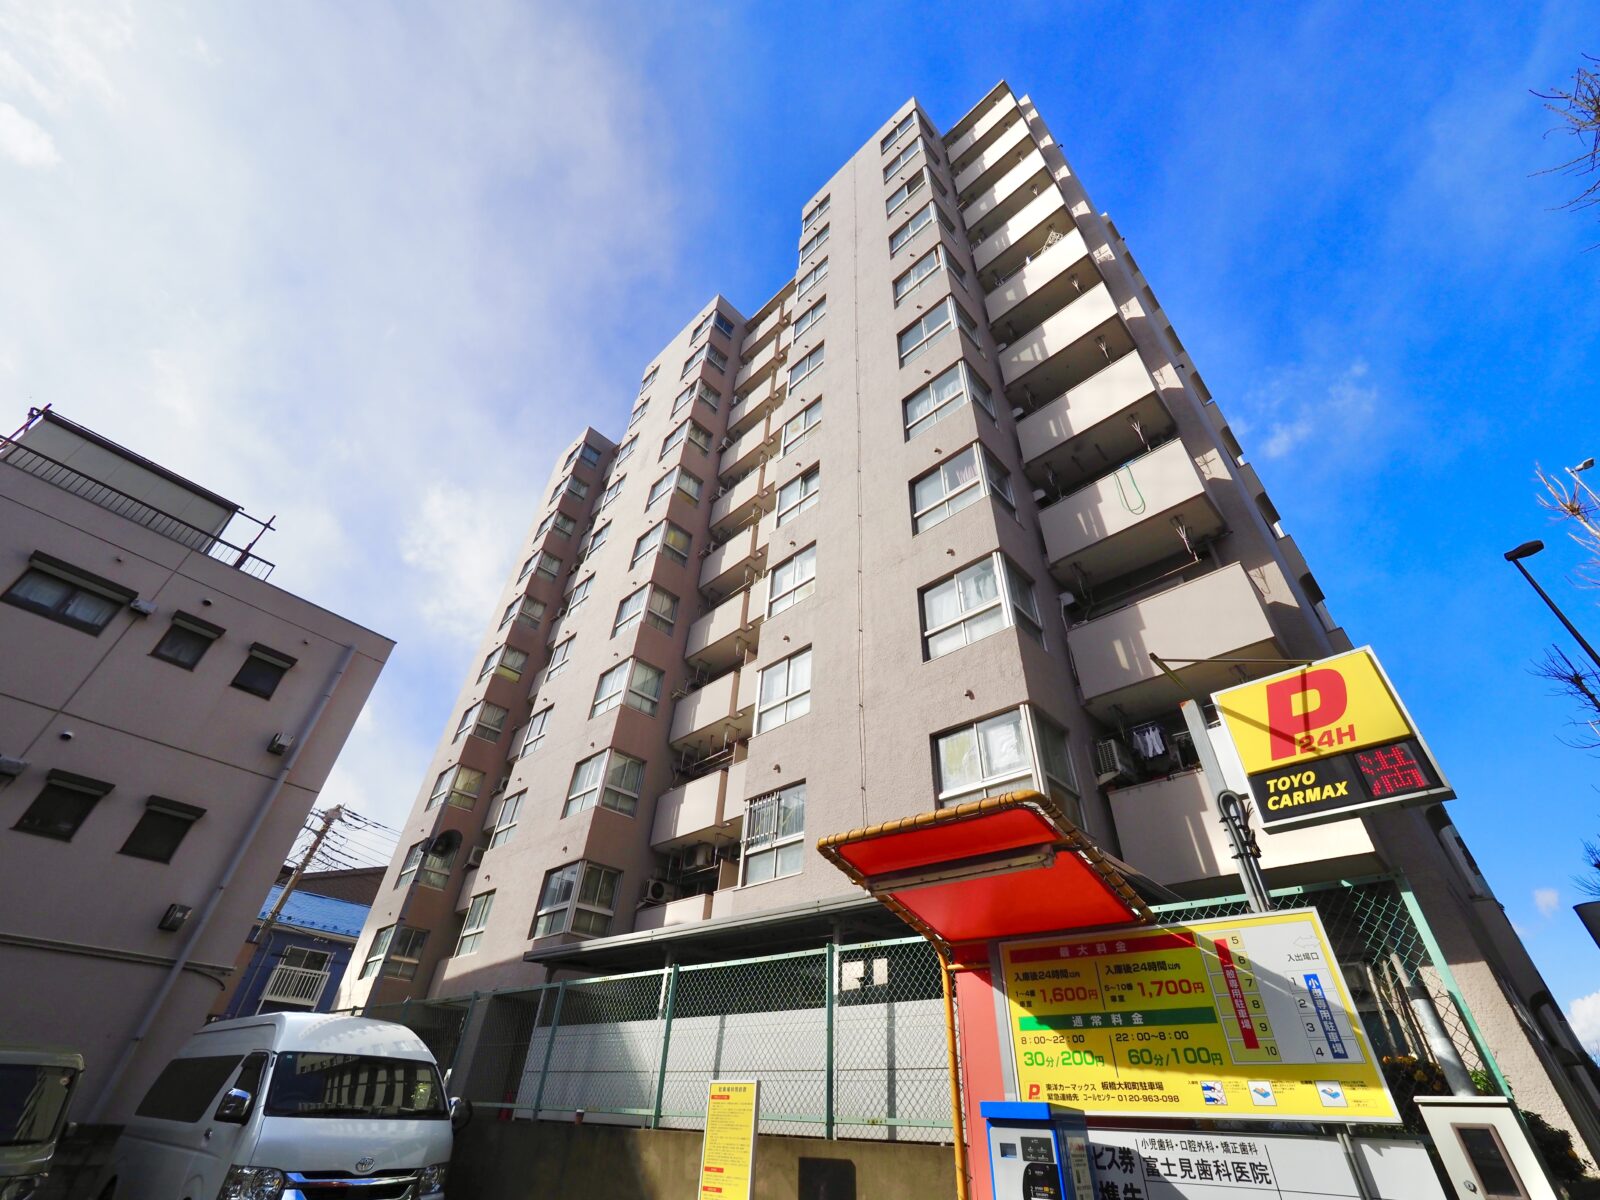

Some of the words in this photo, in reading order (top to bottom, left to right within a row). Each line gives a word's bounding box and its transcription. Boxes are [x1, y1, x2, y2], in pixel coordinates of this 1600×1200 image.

[1266, 668, 1347, 761] P
[1299, 724, 1356, 754] 24H
[1359, 746, 1425, 797] 満
[1266, 771, 1316, 793] TOYO
[1267, 781, 1348, 811] CARMAX
[1231, 937, 1239, 945] 5
[1059, 941, 1127, 957] 最大料金
[1238, 956, 1246, 965] 6
[1287, 952, 1320, 962] 入出場口
[1245, 978, 1253, 987] 7
[1291, 977, 1297, 986] 1
[1137, 979, 1205, 998] 1,700円
[1040, 986, 1098, 1004] 1,600円
[1252, 1000, 1260, 1009] 8
[1298, 999, 1308, 1009] 2
[1072, 1012, 1144, 1027] 通常料金
[1260, 1022, 1268, 1032] 9
[1306, 1023, 1315, 1032] 3
[1265, 1046, 1277, 1056] 10
[1316, 1047, 1324, 1057] 4
[1117, 1094, 1180, 1103] 0120-963-098
[1142, 1155, 1272, 1185] 富士見歯科医院
